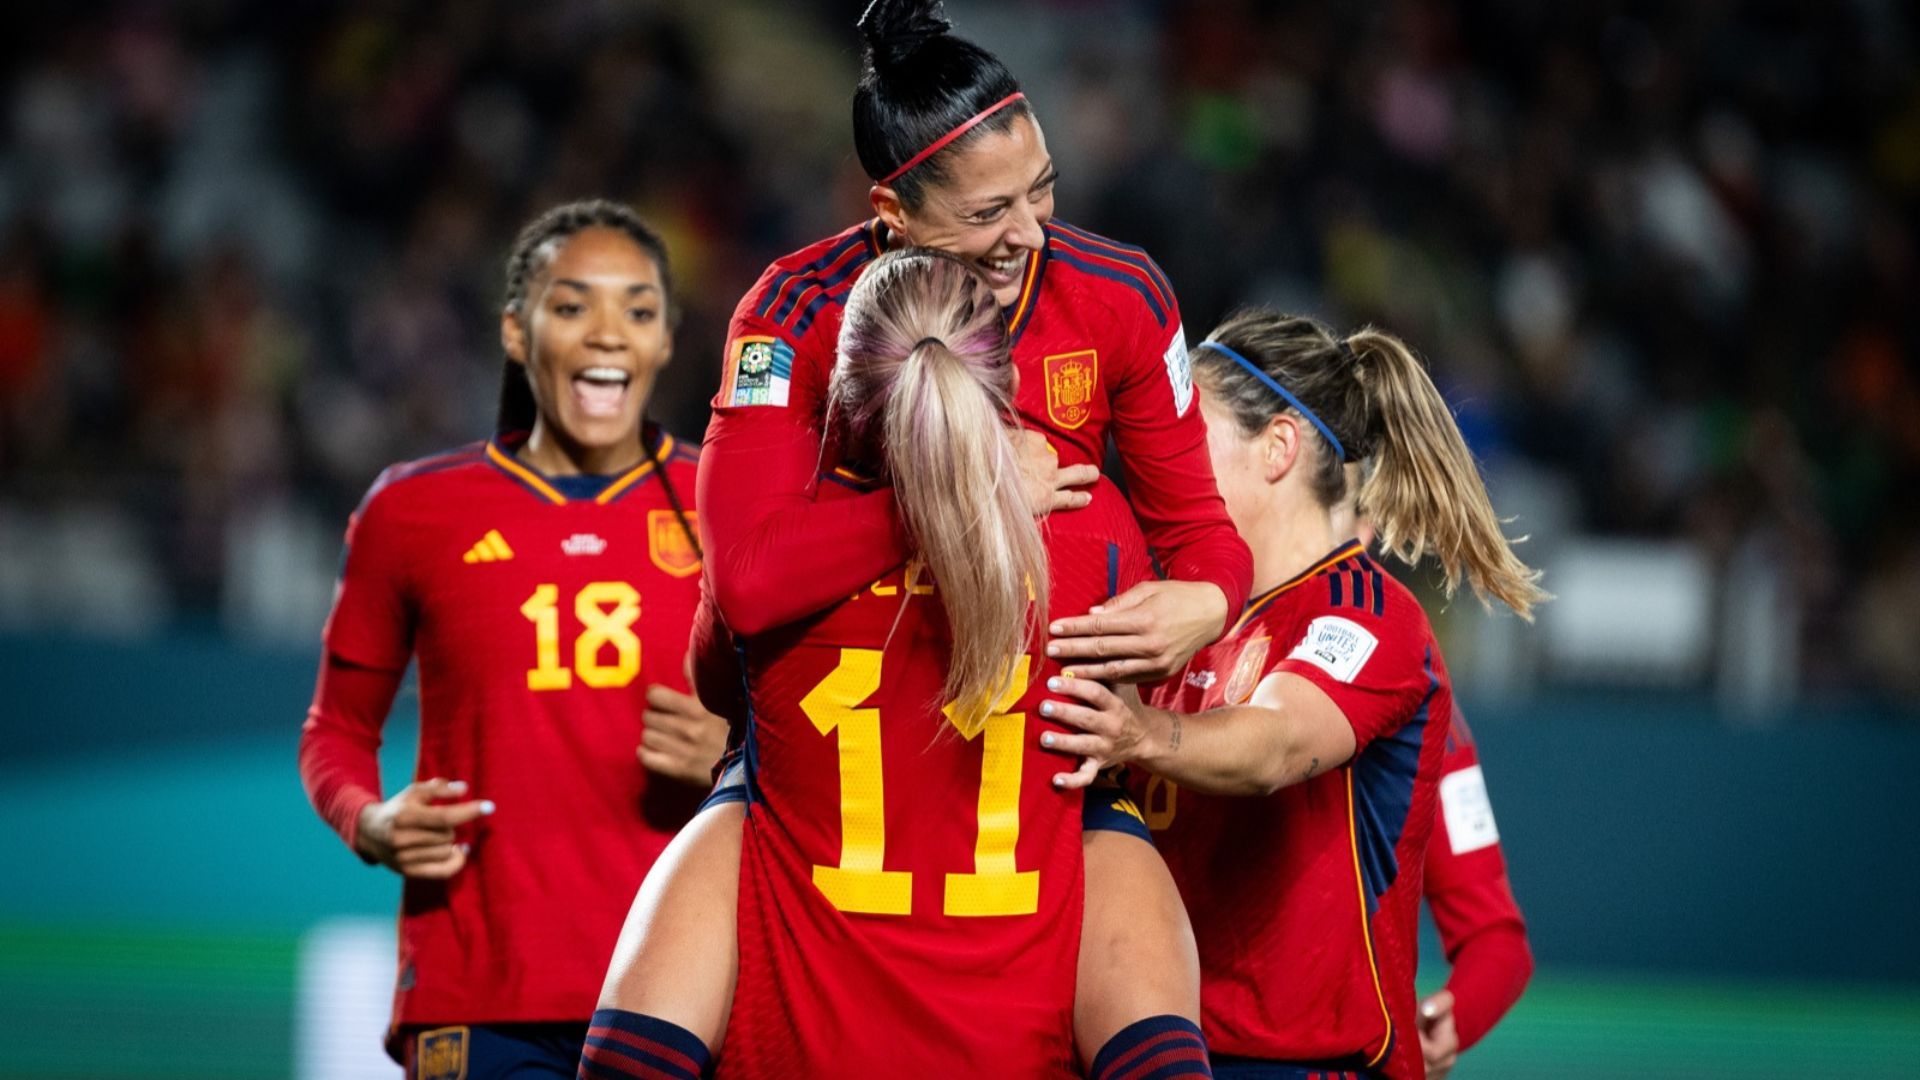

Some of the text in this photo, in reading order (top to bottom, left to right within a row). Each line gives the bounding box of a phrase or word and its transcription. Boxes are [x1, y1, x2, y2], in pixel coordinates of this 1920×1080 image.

[520, 581, 641, 690] 18
[1318, 631, 1357, 653] UNITES
[799, 647, 1040, 917] 11
